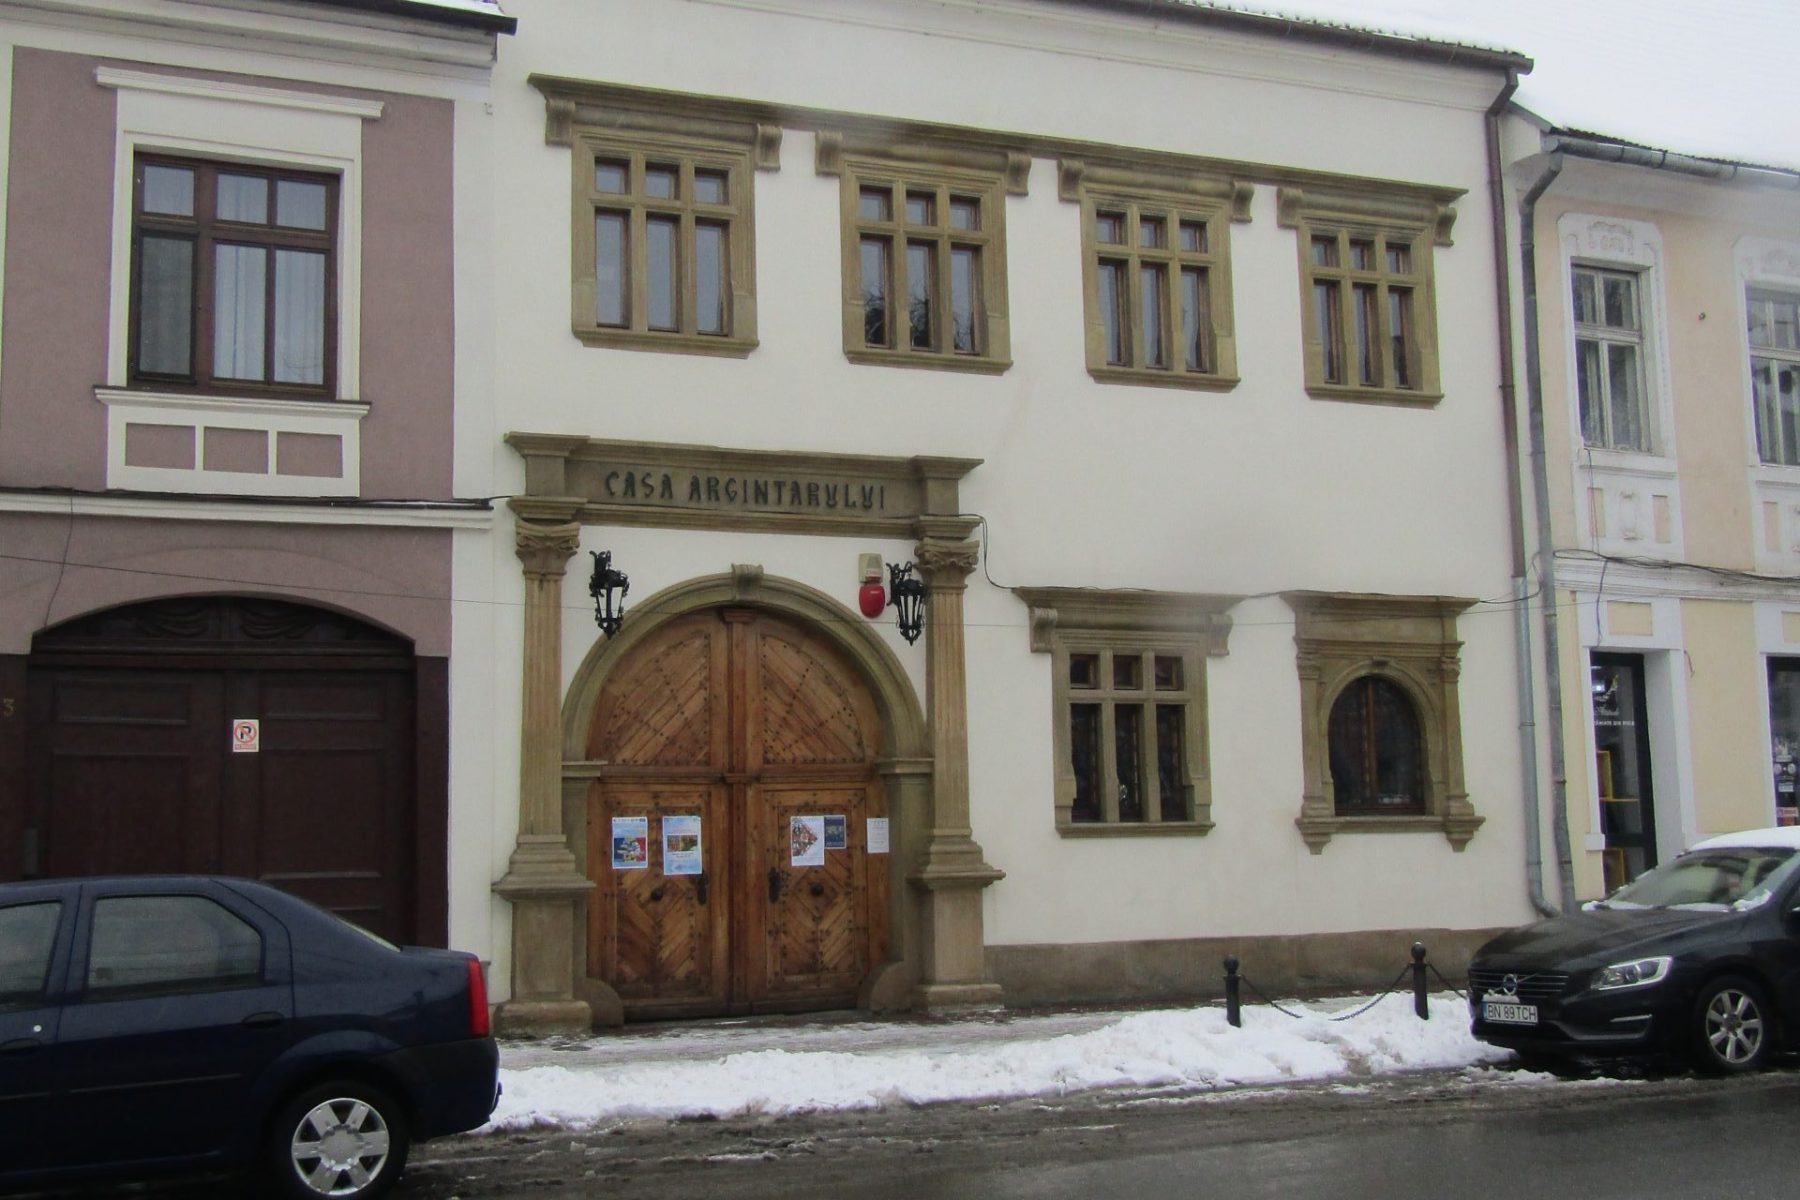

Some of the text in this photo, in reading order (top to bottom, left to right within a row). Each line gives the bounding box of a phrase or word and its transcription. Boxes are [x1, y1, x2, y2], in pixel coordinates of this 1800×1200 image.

[605, 471, 885, 510] CASA ARGINTARULUI
[239, 725, 252, 739] P
[1488, 1004, 1537, 1021] BN 89 TCH
